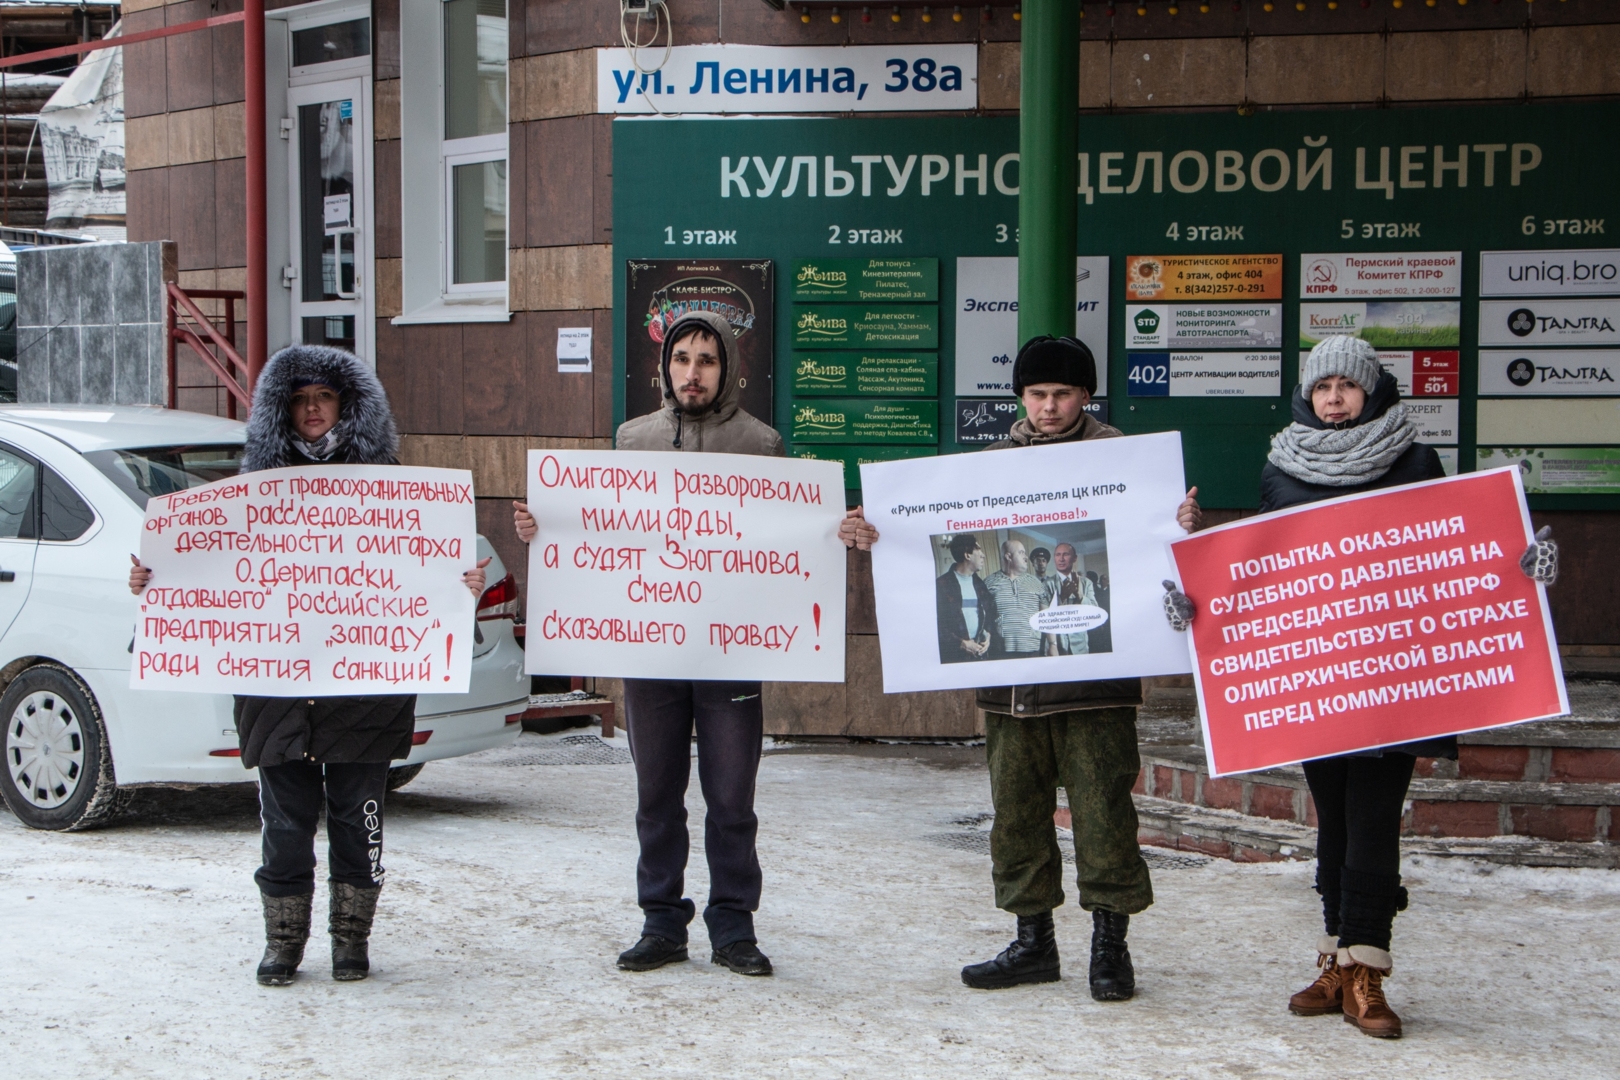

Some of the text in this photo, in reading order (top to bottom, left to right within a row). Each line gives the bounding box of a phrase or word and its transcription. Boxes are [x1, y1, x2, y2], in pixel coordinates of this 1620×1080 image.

[612, 58, 963, 102] ул. Ленина, 38а
[1355, 142, 1543, 199] ЦЕНТР
[995, 224, 1008, 243] 3
[1166, 222, 1244, 241] 4 этаж
[1341, 219, 1421, 239] 5 этаж
[1522, 216, 1605, 235] 6 этаж
[665, 226, 737, 245] 1 этаж
[828, 226, 903, 244] 2 этаж
[869, 260, 883, 268] Для
[1346, 257, 1455, 269] Пермский краевой
[797, 264, 847, 281] Жива
[1186, 273, 1213, 281] этаж,
[1216, 271, 1242, 280] офис
[1244, 270, 1263, 278] 404
[1358, 270, 1443, 280] Комитет КПРФ
[1508, 260, 1617, 285] uniq.bro
[676, 286, 732, 294] КАФЕ-БИСТРО
[876, 281, 909, 289] Пилатес,
[1185, 284, 1265, 295] 8(342)257-0-291
[1306, 284, 1338, 294] КПРФ
[859, 291, 912, 299] Тренажерный
[797, 312, 847, 328] Жива
[865, 312, 879, 320] Для
[1207, 309, 1270, 317] ВОЗМОЖНОСТИ
[1138, 318, 1156, 327] STD
[1536, 316, 1615, 333] TANTRA
[797, 358, 846, 375] Жива
[862, 357, 876, 365] Для
[992, 354, 1012, 365] оф.
[1422, 358, 1431, 367] 5
[1128, 366, 1167, 384] 402
[1238, 370, 1280, 378] ВОДИТЕЛЕЙ
[1536, 366, 1615, 383] TANTRA
[1424, 383, 1448, 393] 501
[795, 406, 846, 423] Жива
[1422, 430, 1439, 438] офис
[539, 455, 822, 507] Олигархи разворовали
[157, 476, 473, 510] Требуем от правоохранительных
[891, 482, 1126, 517] «Руки прочь от Председателя ЦК КПРФ
[146, 498, 422, 534] органов расследования
[947, 507, 1089, 531] Геннадия Зюганова!»
[175, 529, 462, 566] деятельности олигарха
[1229, 515, 1465, 581] ПОПЫТКА ОКАЗАНИЯ
[544, 533, 811, 581] а судят Зюганова,
[1209, 540, 1503, 616] СУДЕБНОГО ДАВЛЕНИЯ НА
[287, 590, 429, 618] российские
[1221, 572, 1501, 643] ПРЕДСЕДАТЕЛЯ ЦК КПРФ
[144, 617, 300, 646] предприятия
[1209, 598, 1529, 676] СВИДЕТЕЛЬСТВУЕТ О СТРАХЕ
[139, 651, 200, 679] ради
[217, 652, 311, 682] снятия
[1224, 631, 1525, 705] ОЛИГАРХИЧЕСКОЙ ВЛАСТИ
[1244, 665, 1515, 732] ПЕРЕД КОММУНИСТАМИ
[363, 799, 381, 844] neo
